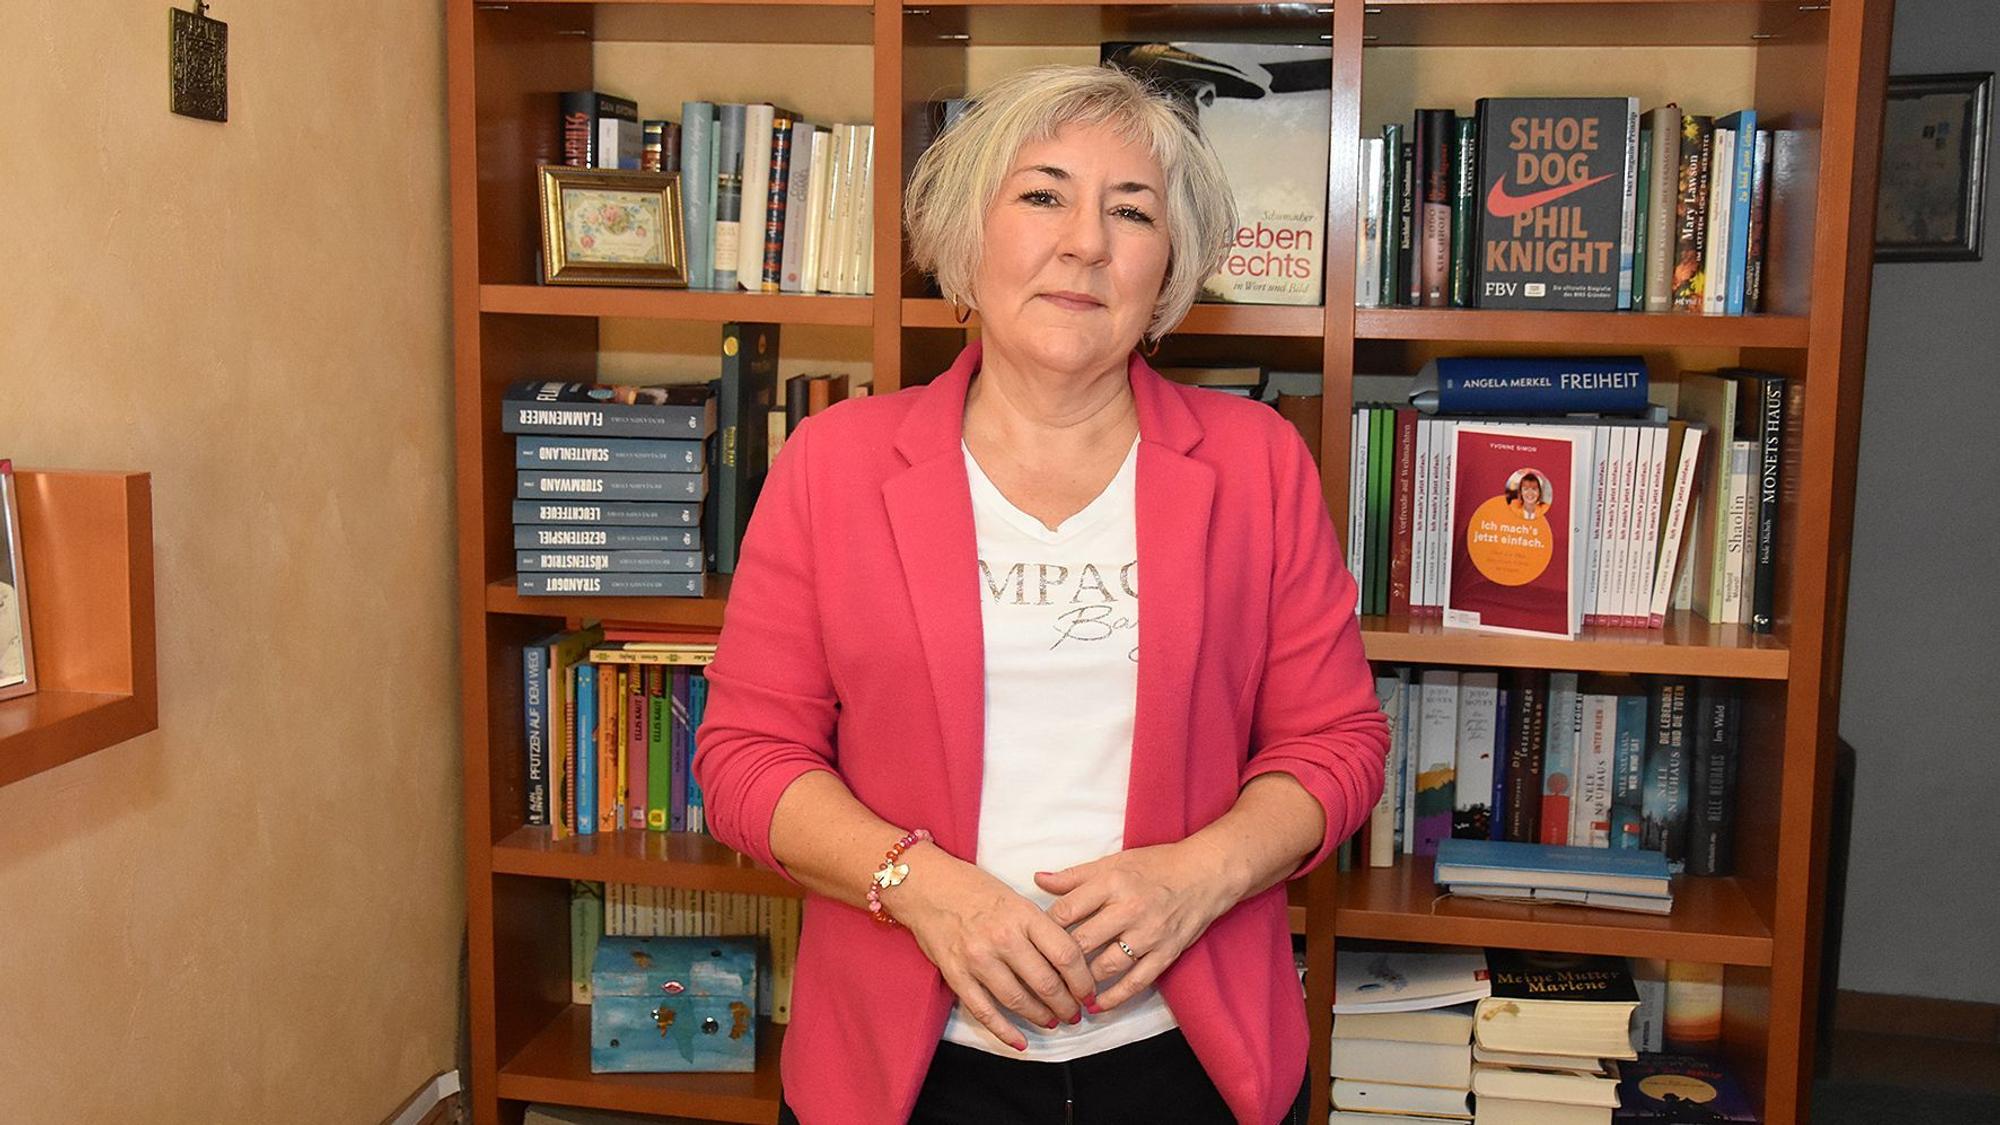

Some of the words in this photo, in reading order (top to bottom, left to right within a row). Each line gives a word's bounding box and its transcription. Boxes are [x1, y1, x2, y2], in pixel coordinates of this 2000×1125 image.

[1509, 117, 1598, 150] SHOE
[1701, 134, 1709, 172] HERBSTES
[1517, 152, 1589, 185] DOG
[1684, 155, 1698, 202] Lawson
[1513, 206, 1588, 238] PHIL
[1682, 208, 1697, 239] Mary
[1486, 240, 1613, 273] KNIGHT
[1245, 281, 1266, 291] Wort
[1268, 283, 1286, 292] und
[1485, 282, 1517, 296] FBV
[1463, 378, 1508, 388] ANGELA
[1510, 377, 1552, 387] MERKEL
[1560, 372, 1640, 390] FREIHEIT
[520, 409, 603, 427] FLAMMENMEER
[1766, 390, 1781, 432] HAUS
[538, 446, 609, 461] SCHATTENLAND
[1401, 424, 1411, 475] Weihnachten
[1489, 443, 1515, 451] YVONNE
[1763, 437, 1778, 503] MONETS
[540, 478, 603, 493] STURMWAND
[1400, 478, 1409, 492] auf
[540, 506, 600, 520] LEUCHTFEUER
[1398, 494, 1408, 534] Vorfreude
[1481, 520, 1497, 531] Ich
[1500, 522, 1539, 536] mach's
[1728, 495, 1744, 553] Shaolin
[538, 530, 607, 545] GEZEITENSPIEL
[1473, 531, 1498, 544] jetzt
[1501, 534, 1545, 549] einfach.
[540, 554, 609, 570] KÜSTENSTRICH
[546, 577, 601, 592] STRANDGUT
[528, 652, 538, 678] WEG
[529, 680, 539, 704] DEM
[1523, 688, 1533, 713] Tage
[1672, 685, 1685, 710] TOTEN
[634, 699, 642, 719] KAUT
[653, 701, 661, 720] KAUT
[1659, 686, 1672, 728] LEBENDEN
[1714, 705, 1725, 727] Wald
[529, 708, 540, 728] AUF
[1672, 715, 1683, 727] DIE
[634, 721, 642, 741] ELLIS
[653, 723, 661, 742] ELLIS
[1521, 717, 1530, 757] letzten
[1659, 732, 1669, 744] DIE
[1671, 730, 1682, 746] UND
[1713, 730, 1723, 742] Im
[1512, 750, 1520, 768] Die
[1585, 773, 1594, 802] NELE
[1594, 759, 1606, 816] NEUHAUS
[1667, 751, 1680, 811] NEUHAUS
[1497, 972, 1553, 985] Meine
[1528, 981, 1607, 993] Marlene
